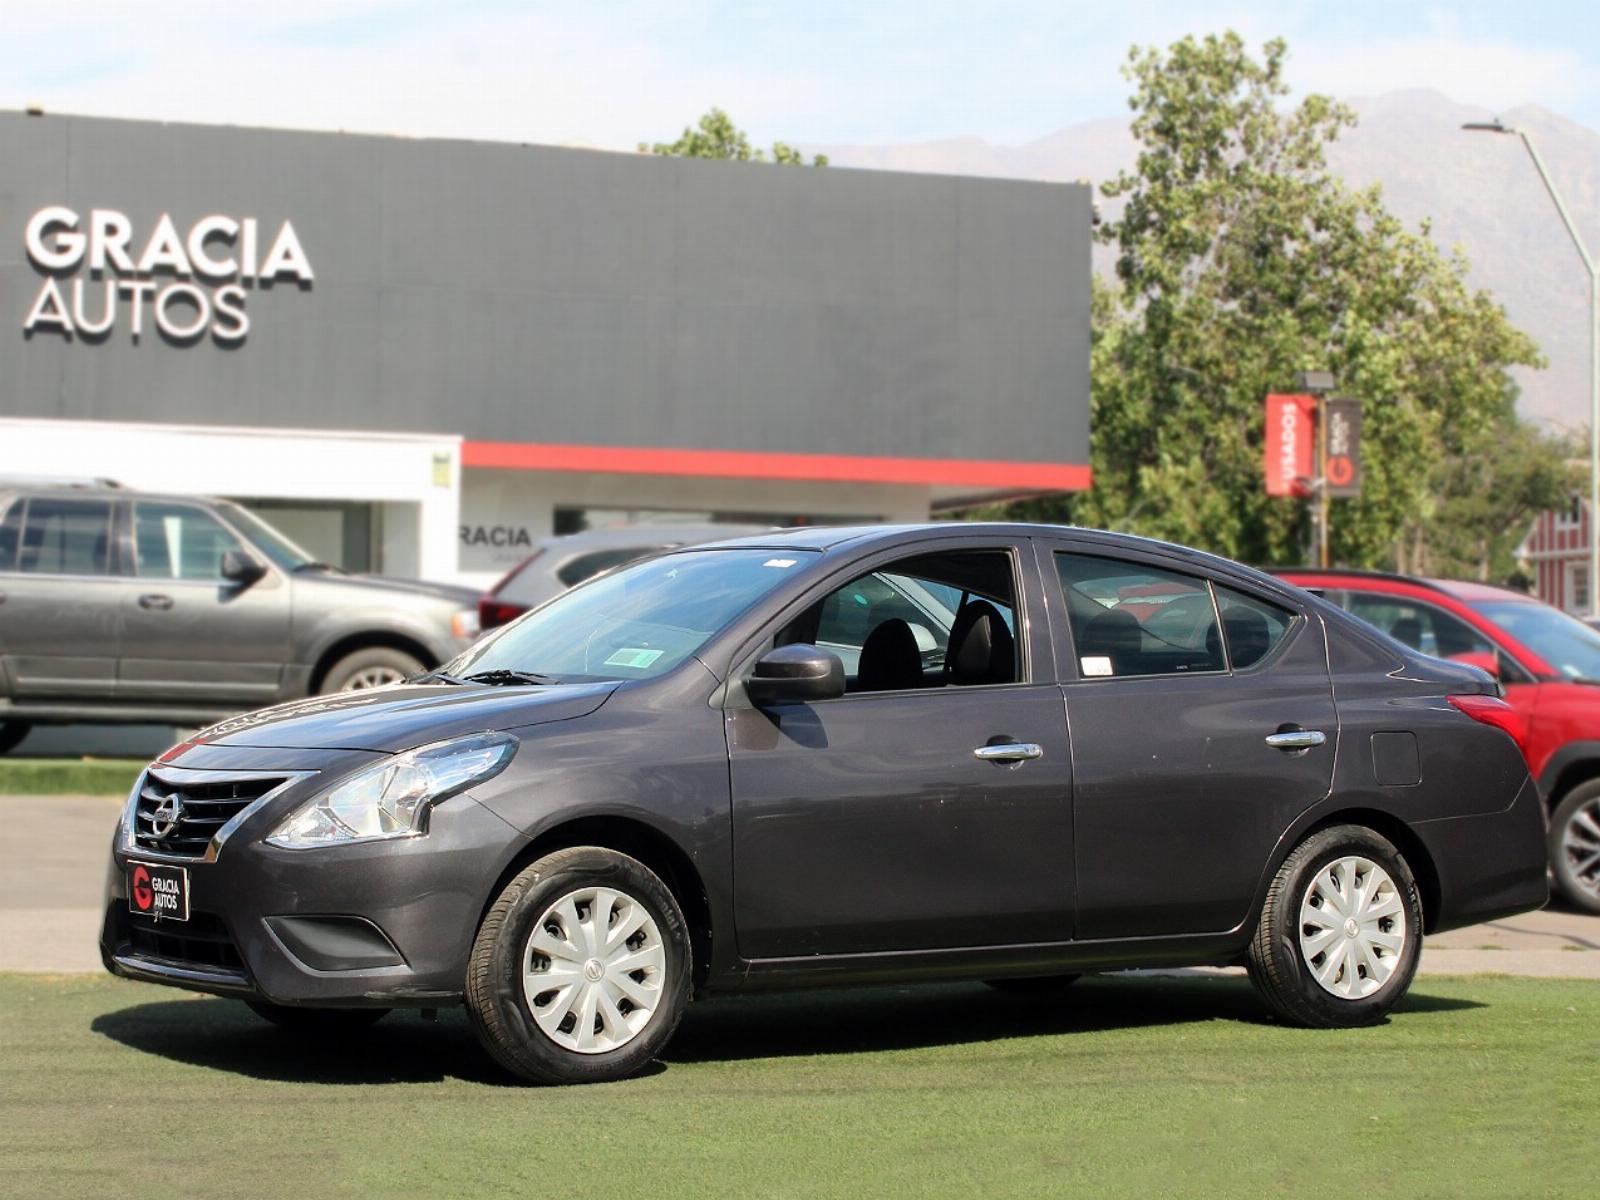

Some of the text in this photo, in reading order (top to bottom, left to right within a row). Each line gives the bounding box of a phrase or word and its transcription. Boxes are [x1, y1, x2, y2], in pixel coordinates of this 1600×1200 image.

[25, 206, 314, 280] GRACIA
[24, 277, 249, 340] AUTOS
[1281, 402, 1297, 480] USADOS
[459, 525, 532, 546] RACIA
[152, 877, 180, 895] GRACIA
[154, 892, 178, 910] AUTOS
